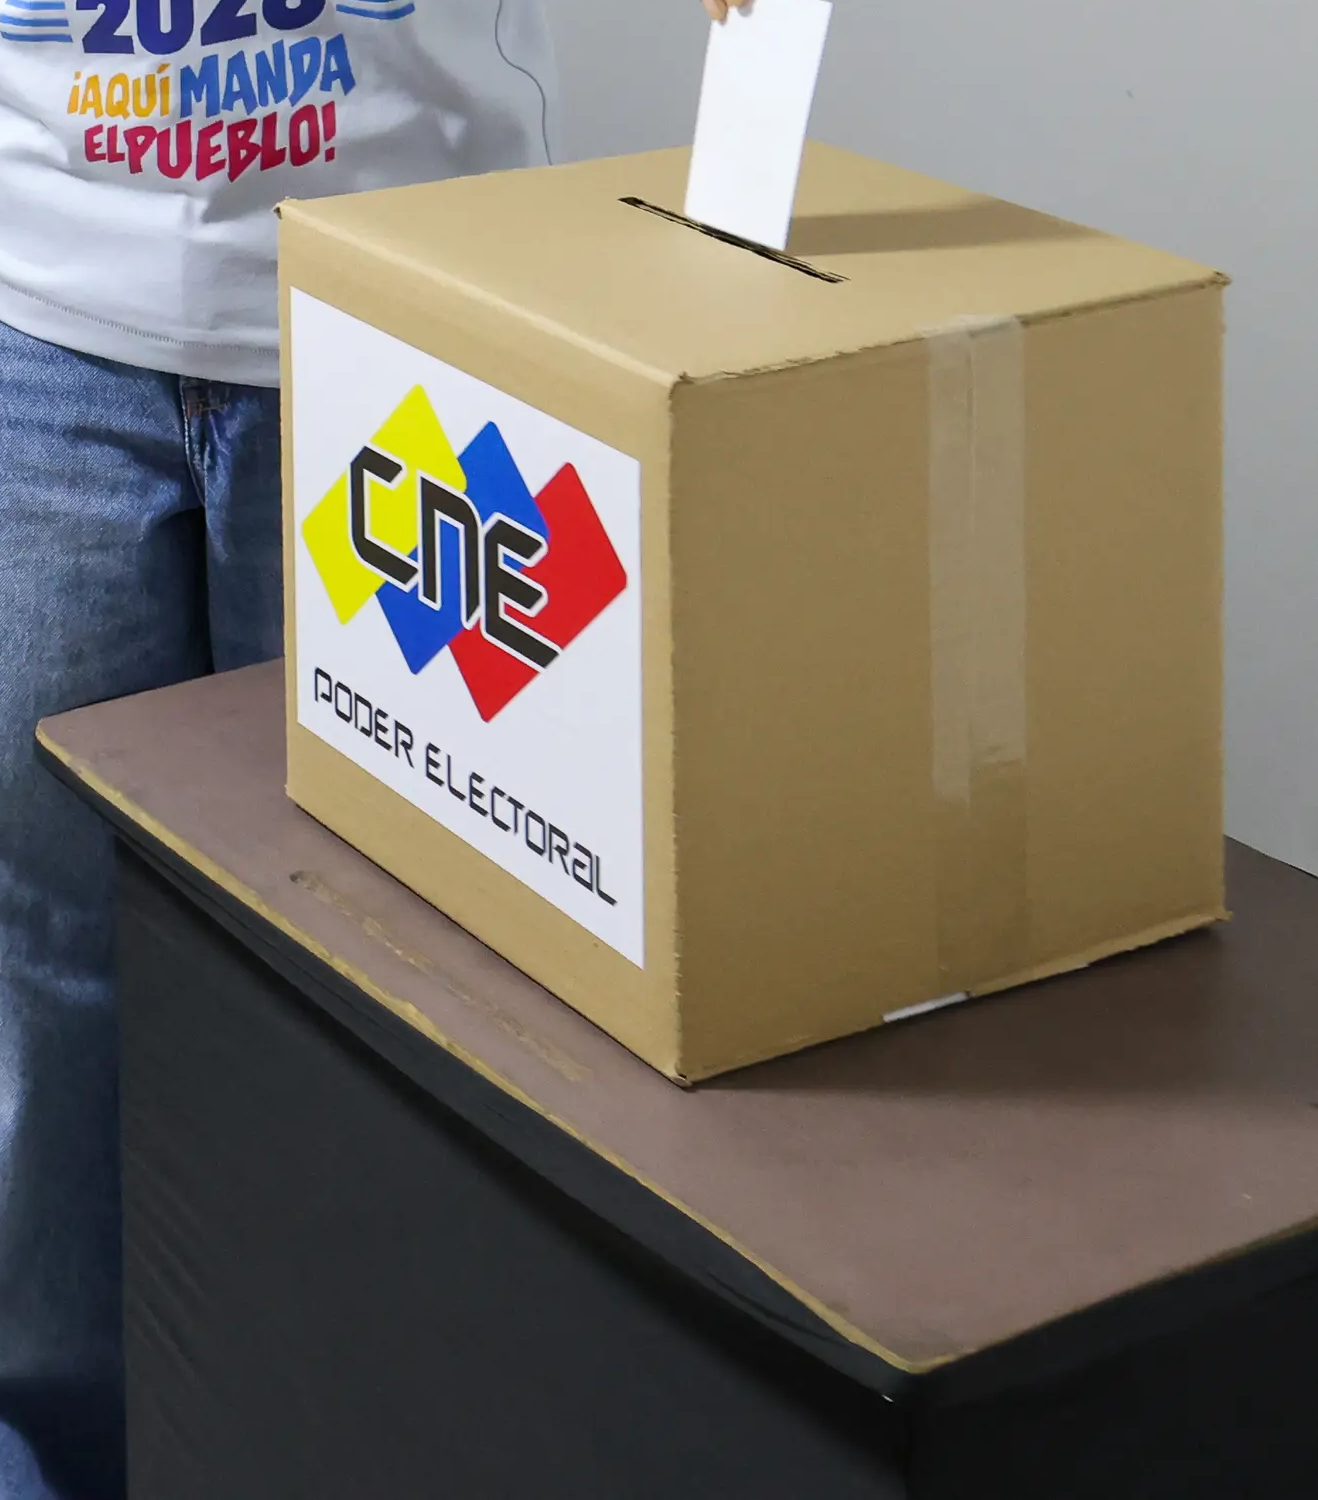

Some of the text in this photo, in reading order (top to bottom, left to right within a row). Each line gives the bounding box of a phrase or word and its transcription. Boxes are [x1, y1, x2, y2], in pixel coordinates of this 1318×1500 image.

[68, 33, 356, 118] ¡AQUÍ MANDA
[350, 445, 561, 670] CNE
[314, 667, 618, 905] PODER ELECTORAL
